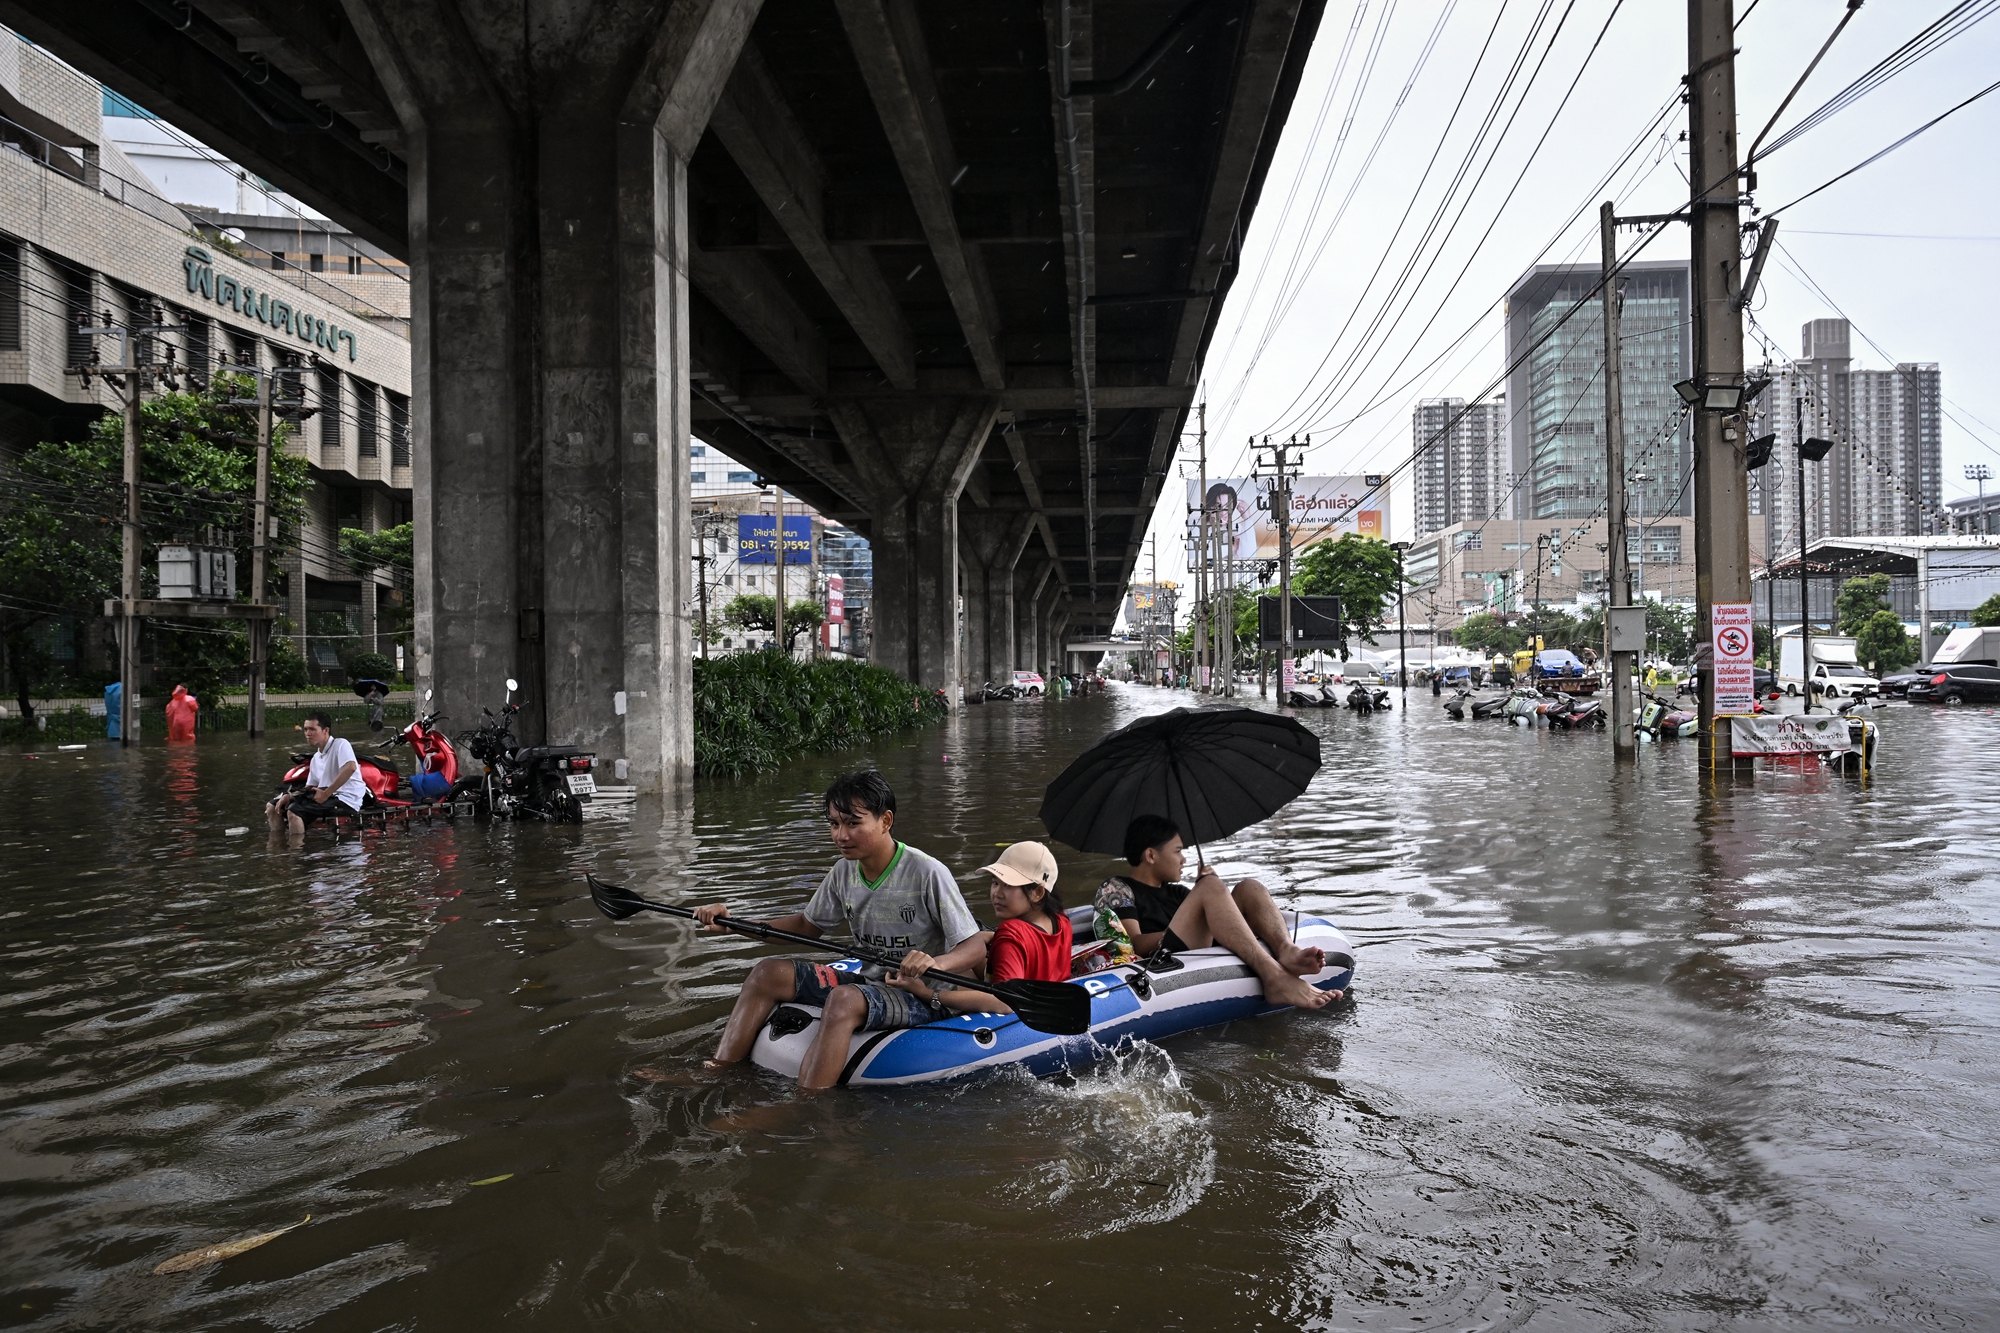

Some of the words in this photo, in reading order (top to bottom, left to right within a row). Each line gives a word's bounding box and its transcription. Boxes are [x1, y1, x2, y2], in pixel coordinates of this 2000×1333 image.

[1360, 520, 1374, 528] LYO
[740, 540, 759, 550] 081
[1778, 719, 1804, 733] ห้าม
[1780, 741, 1813, 752] 5,000
